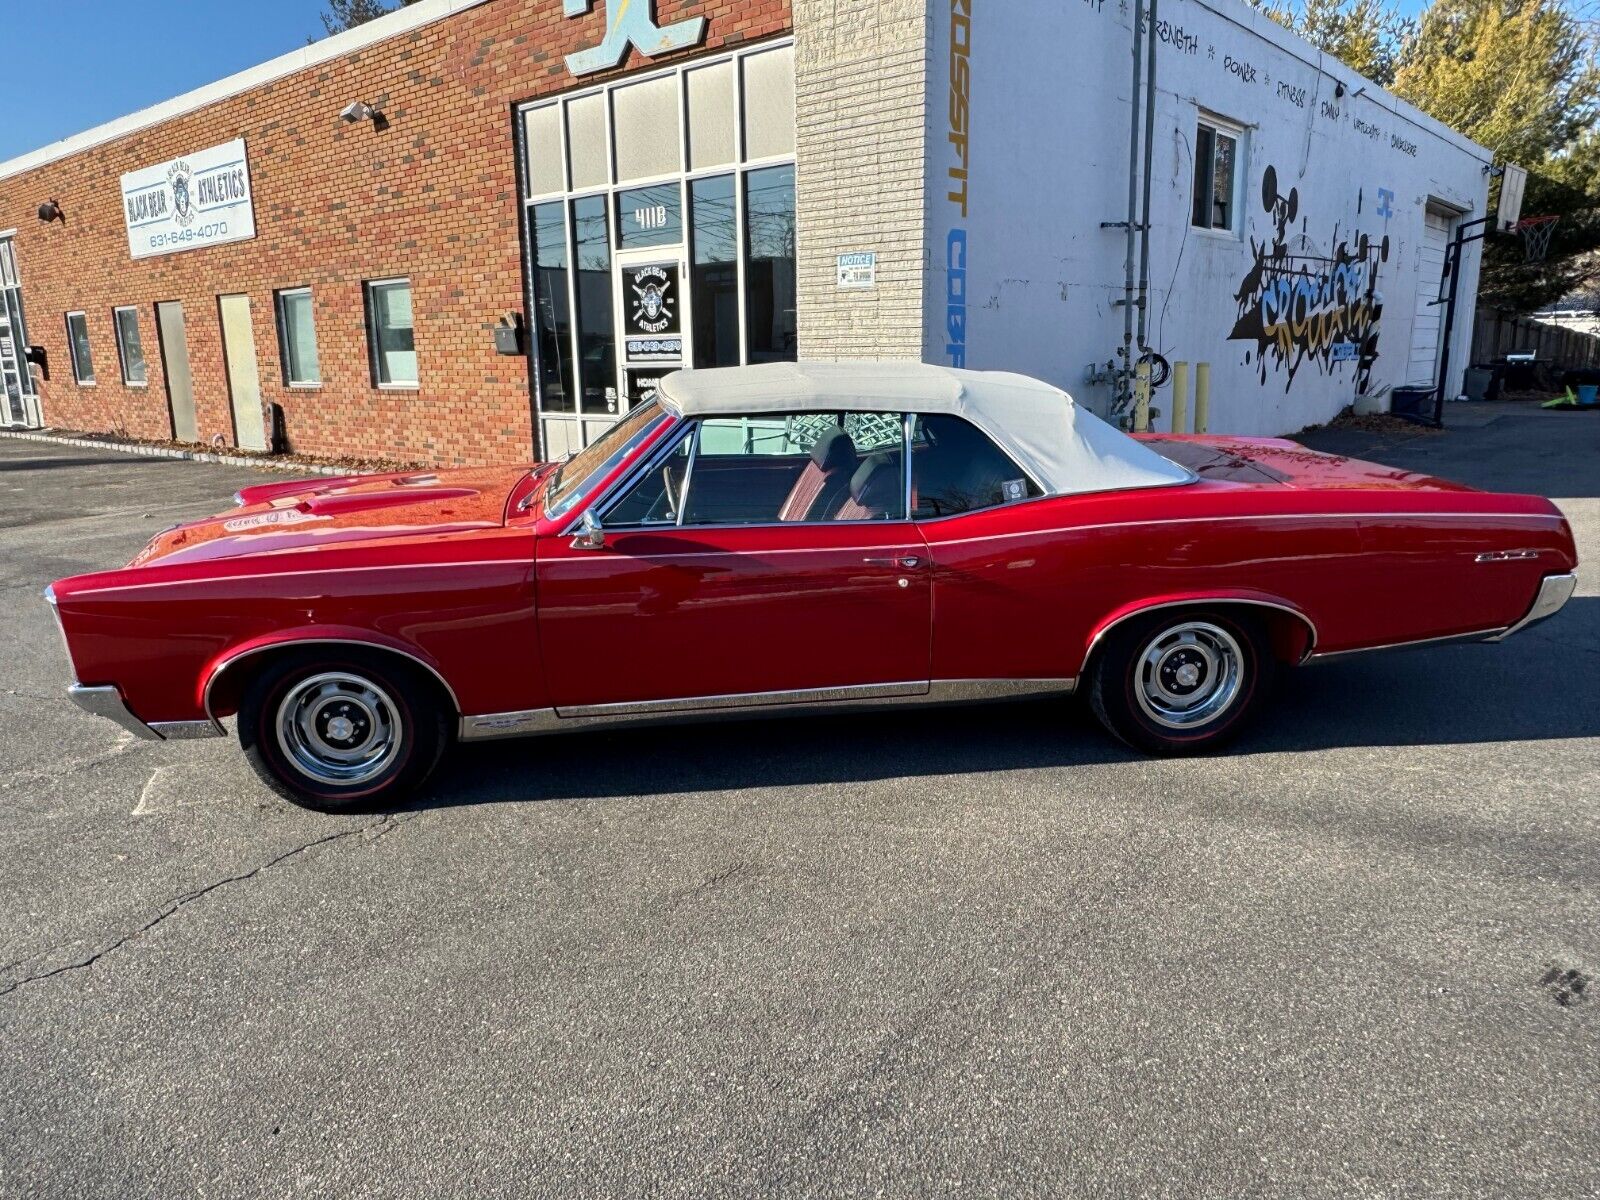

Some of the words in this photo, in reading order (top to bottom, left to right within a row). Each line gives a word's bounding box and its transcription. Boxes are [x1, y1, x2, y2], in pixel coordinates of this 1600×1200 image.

[1223, 54, 1257, 83] POWER
[1277, 81, 1306, 108] FITNESS
[127, 194, 149, 222] BLACK
[148, 189, 168, 218] BEAR
[198, 168, 245, 206] ATHLETICS
[635, 205, 667, 230] 411B
[150, 221, 228, 247] 631-649-4070
[841, 254, 872, 265] NOTICE
[634, 266, 652, 284] BLACK
[651, 266, 667, 281] BEAR
[639, 318, 669, 332] ATHLETICS
